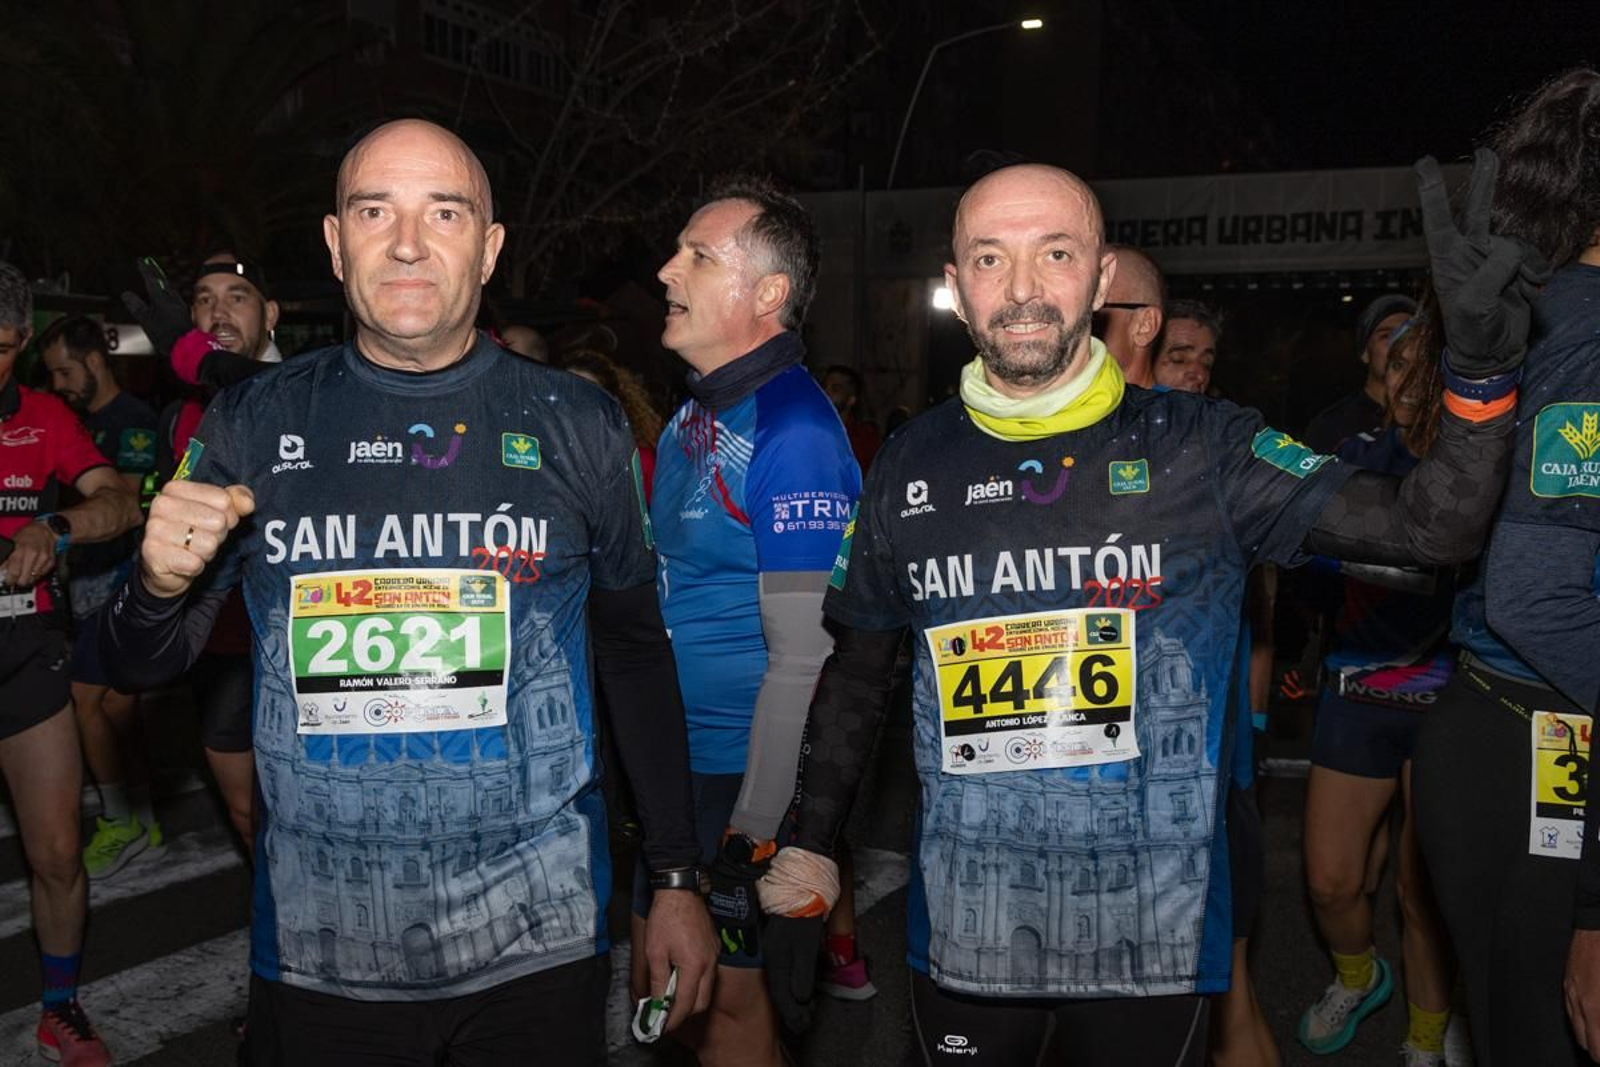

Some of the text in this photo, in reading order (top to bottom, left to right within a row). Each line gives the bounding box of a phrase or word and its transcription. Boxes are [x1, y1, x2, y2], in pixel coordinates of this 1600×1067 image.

[1218, 210, 1363, 244] URBANA
[3, 474, 33, 488] club
[1541, 463, 1578, 475] CAJA
[790, 499, 850, 520] TRM
[265, 503, 547, 564] SAN ANTÓN
[471, 546, 547, 583] 2025
[907, 533, 1161, 601] SAN ANTÓN
[336, 579, 373, 607] 42
[374, 592, 401, 605] SAN
[1083, 576, 1165, 611] 2025
[307, 615, 481, 674] 2621
[971, 626, 1005, 653] 42
[1006, 635, 1032, 649] SAN
[339, 677, 374, 688] RAMÓN
[376, 677, 412, 686] VALERO
[952, 654, 1119, 715] 4446
[985, 718, 1020, 729] ANTONIO
